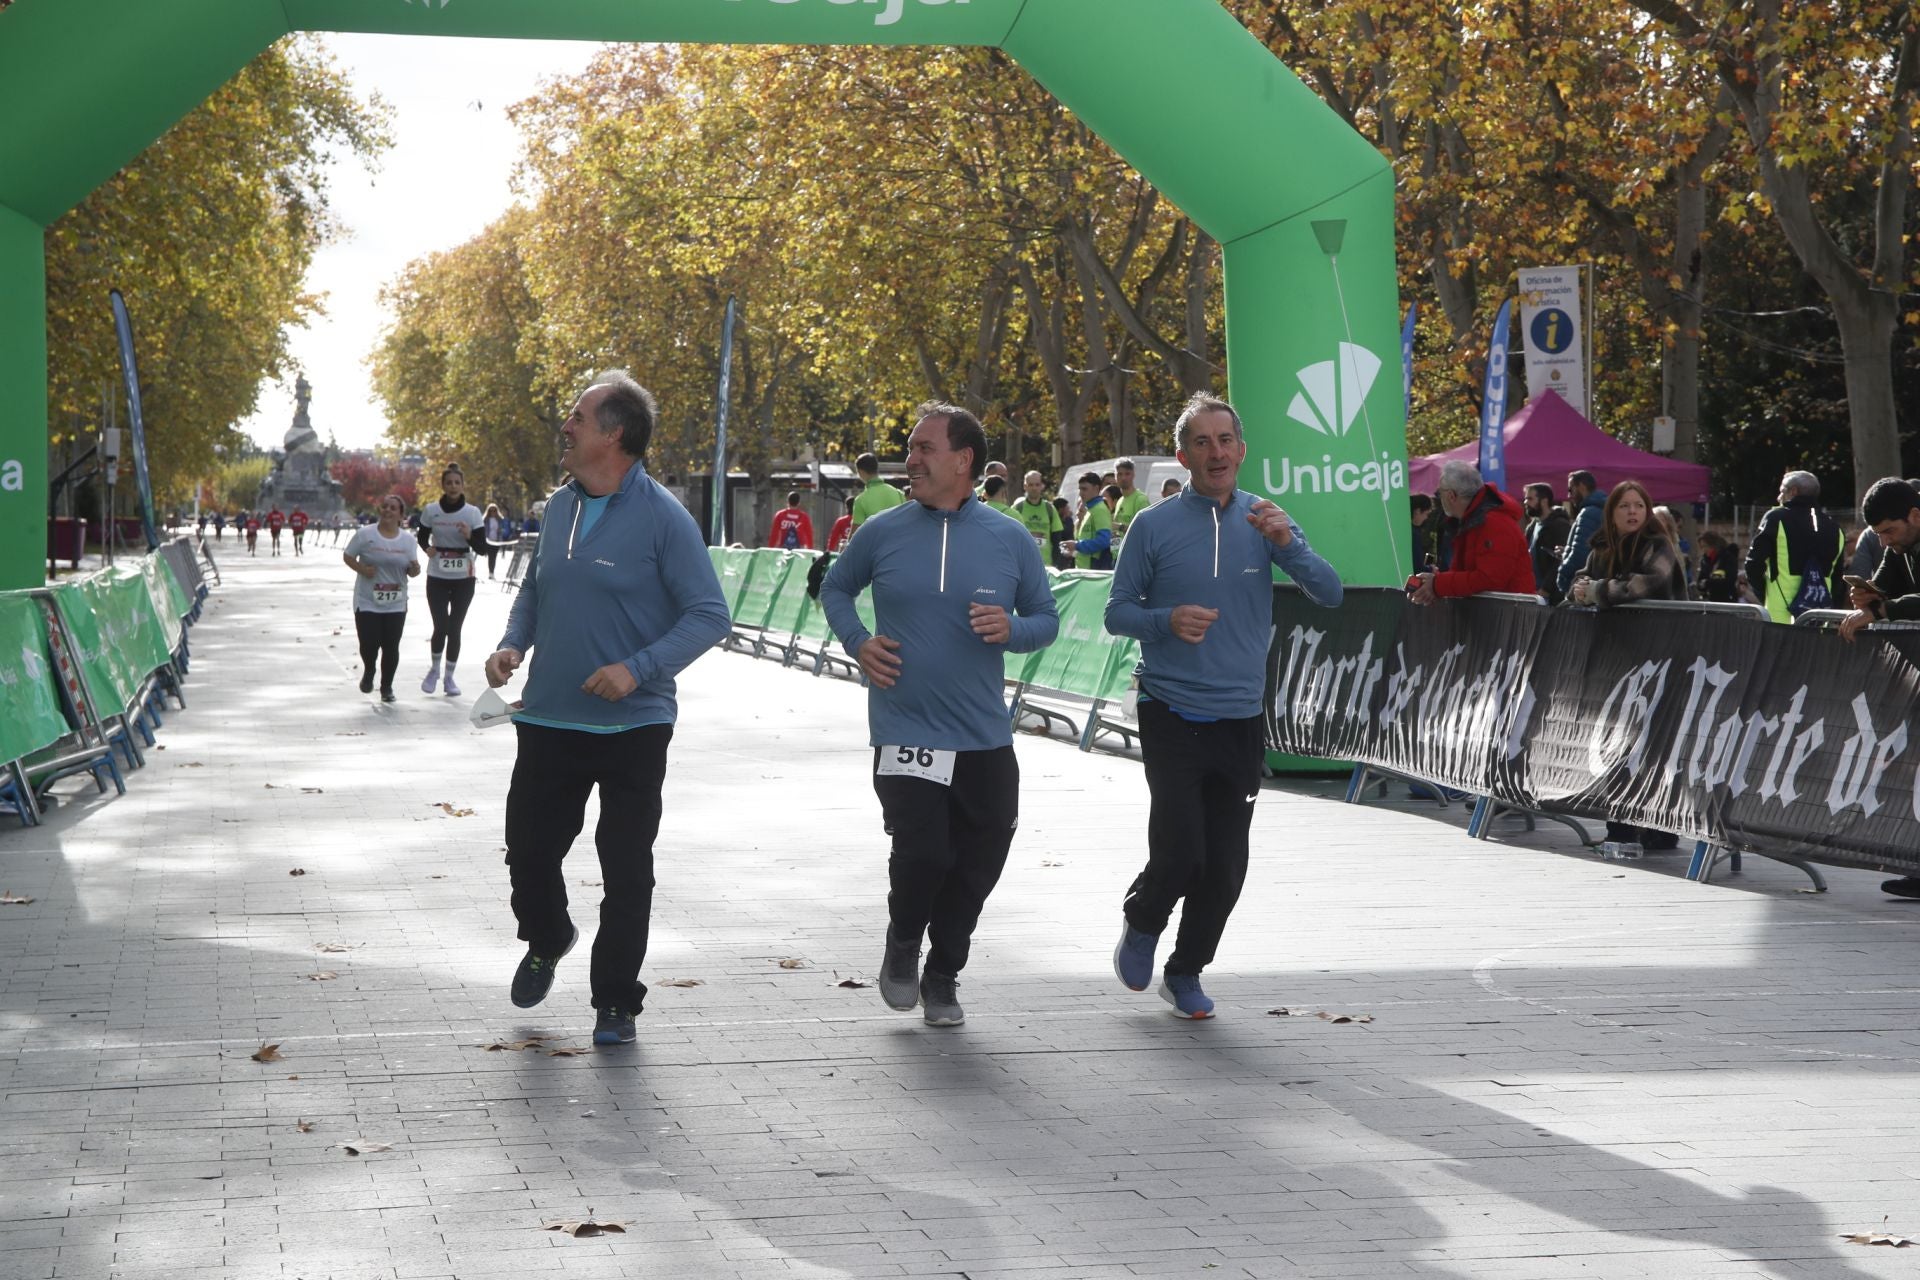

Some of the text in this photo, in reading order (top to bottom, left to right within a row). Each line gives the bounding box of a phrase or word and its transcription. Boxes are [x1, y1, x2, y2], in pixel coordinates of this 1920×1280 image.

[1526, 275, 1562, 285] Oficina de
[1263, 451, 1404, 501] Unicaja
[443, 560, 463, 568] 218
[377, 592, 398, 600] 217
[1275, 625, 1383, 726] Norte
[1663, 656, 1825, 808] Norte
[1825, 691, 1908, 819] de
[897, 746, 934, 767] 56
